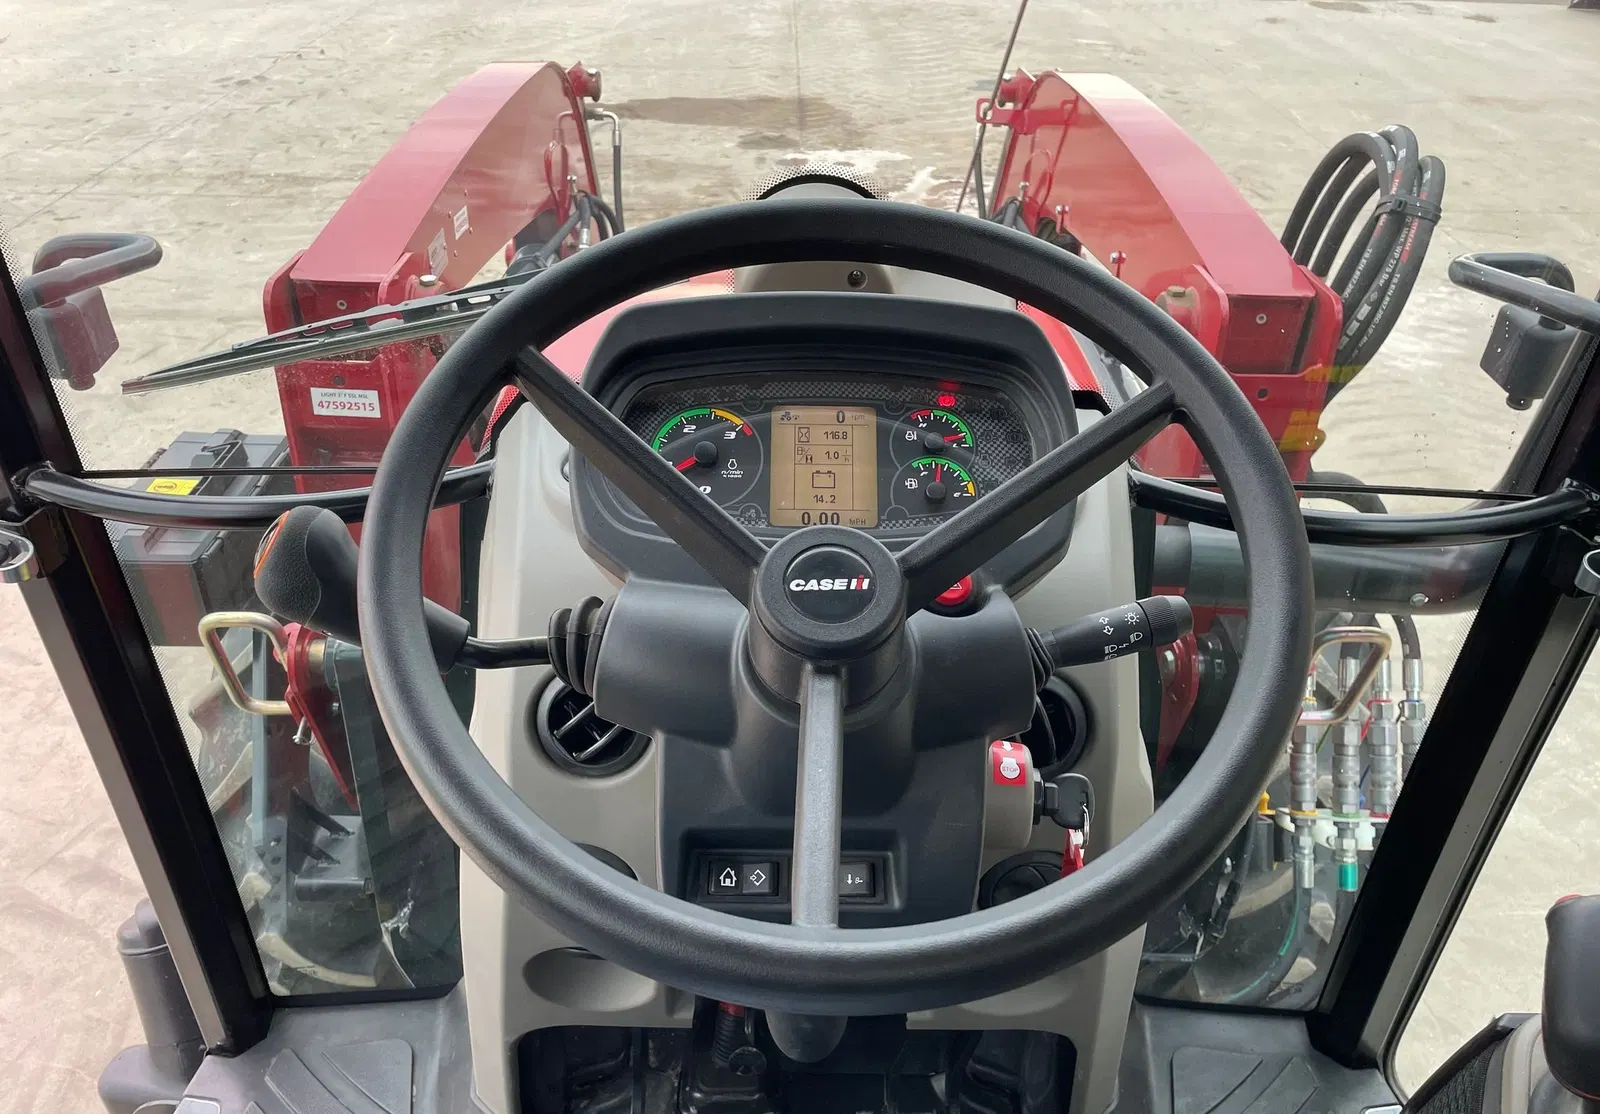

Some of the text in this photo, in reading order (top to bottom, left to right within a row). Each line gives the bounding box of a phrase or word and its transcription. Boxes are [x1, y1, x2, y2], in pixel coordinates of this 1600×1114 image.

[1394, 245, 1404, 258] WP
[1385, 258, 1397, 273] 275
[1378, 273, 1390, 287] Bar
[317, 400, 375, 412] 47592515
[836, 410, 845, 423] 0
[683, 425, 696, 433] 2
[723, 431, 736, 440] 3
[823, 431, 848, 440] 116.8
[825, 451, 840, 460] 1.0
[813, 494, 836, 504] 14.2
[801, 511, 866, 526] 0.00 MPH
[789, 578, 848, 591] CASE
